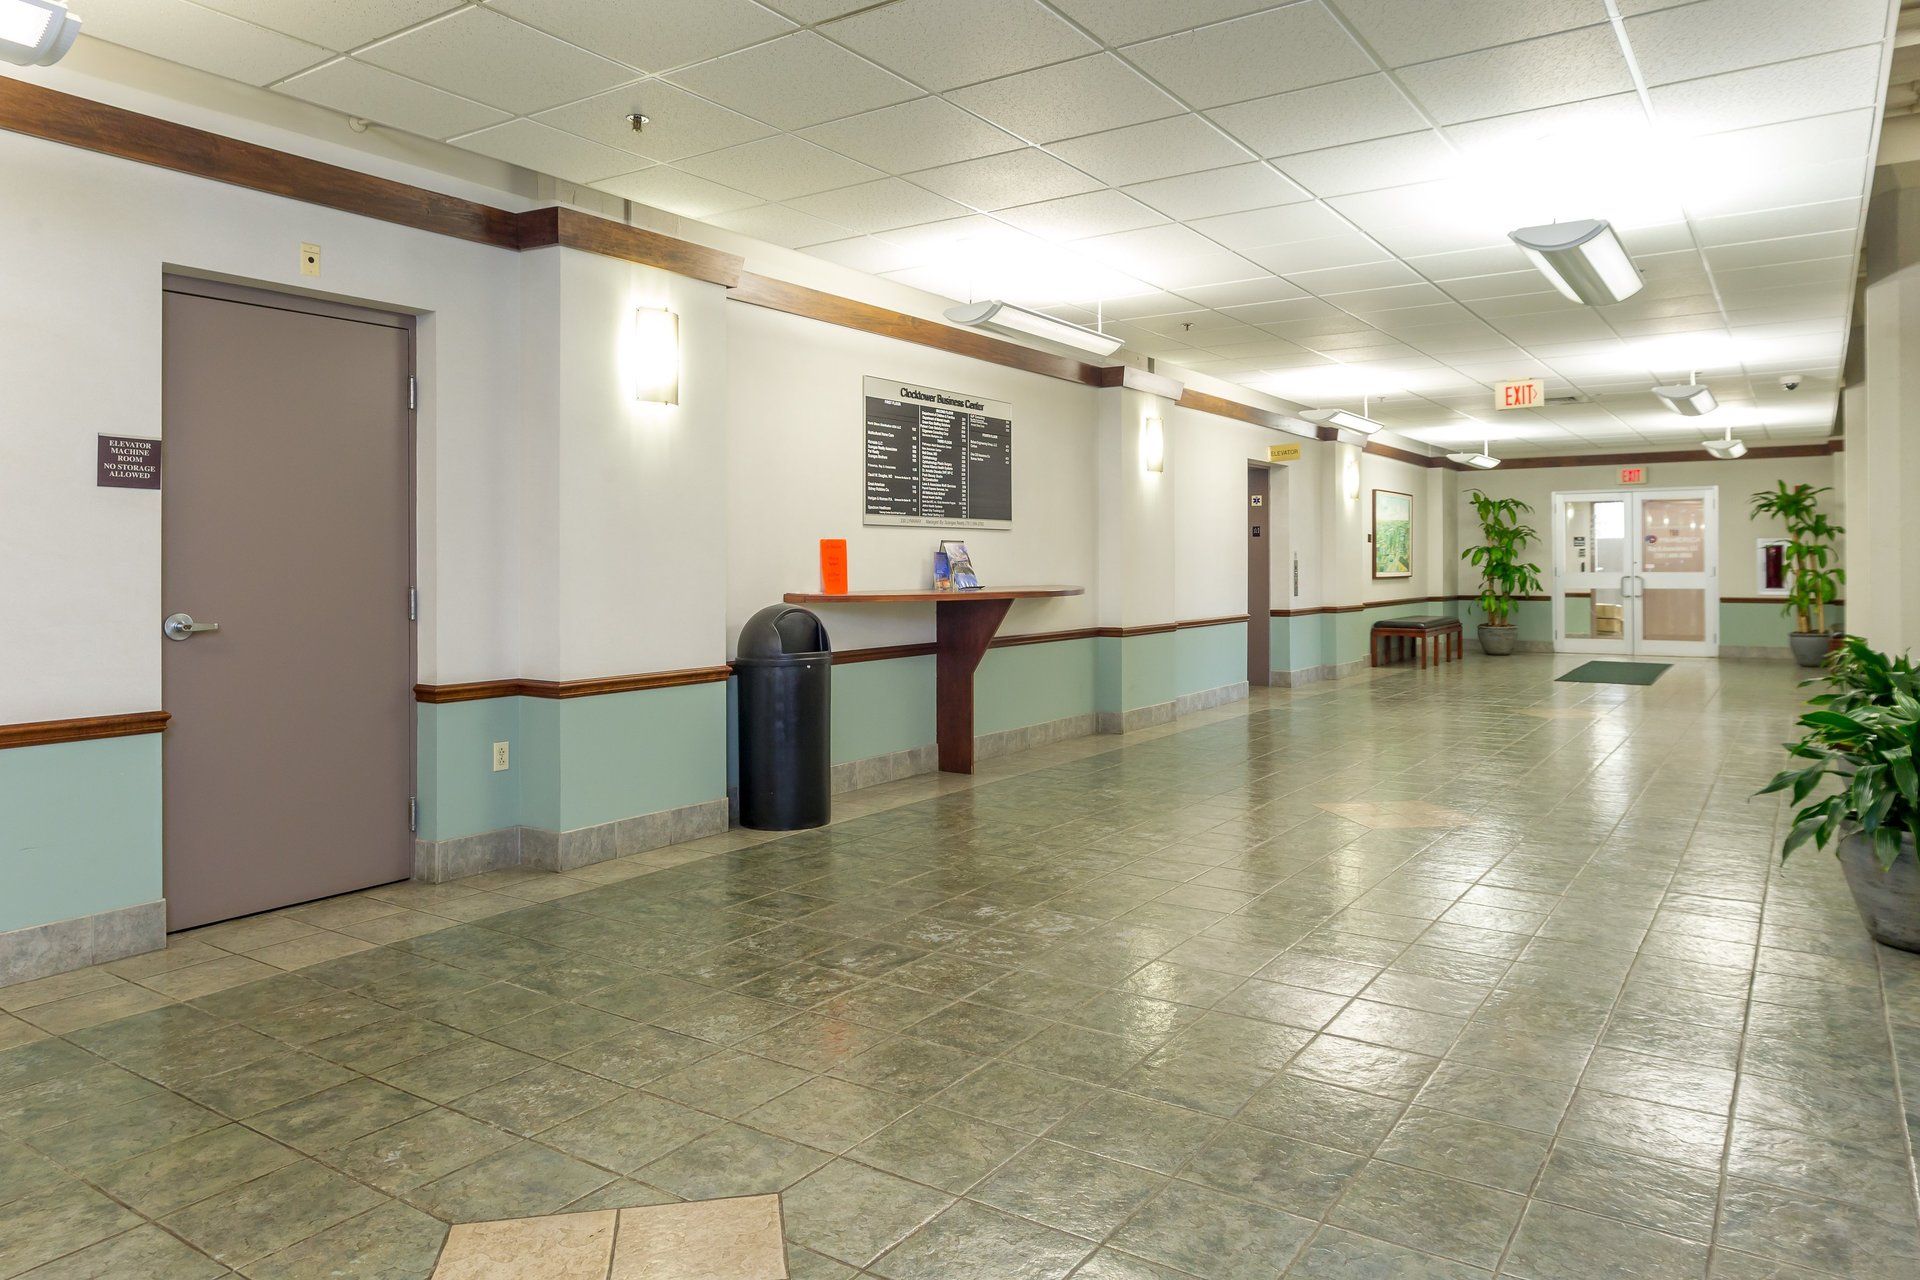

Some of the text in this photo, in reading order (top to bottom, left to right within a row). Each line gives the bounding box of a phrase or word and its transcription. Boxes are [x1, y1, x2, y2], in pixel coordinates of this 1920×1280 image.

[900, 387, 985, 411] Clocktower Business Center
[1505, 384, 1534, 406] EXIT
[109, 440, 152, 449] ELEVATOR
[110, 447, 150, 456] MACHINE
[1270, 449, 1299, 457] ELEVATOR
[117, 455, 143, 463] ROOM
[117, 463, 156, 472] STORAGE
[109, 471, 151, 479] ALLOWED
[1622, 469, 1641, 483] EXIT
